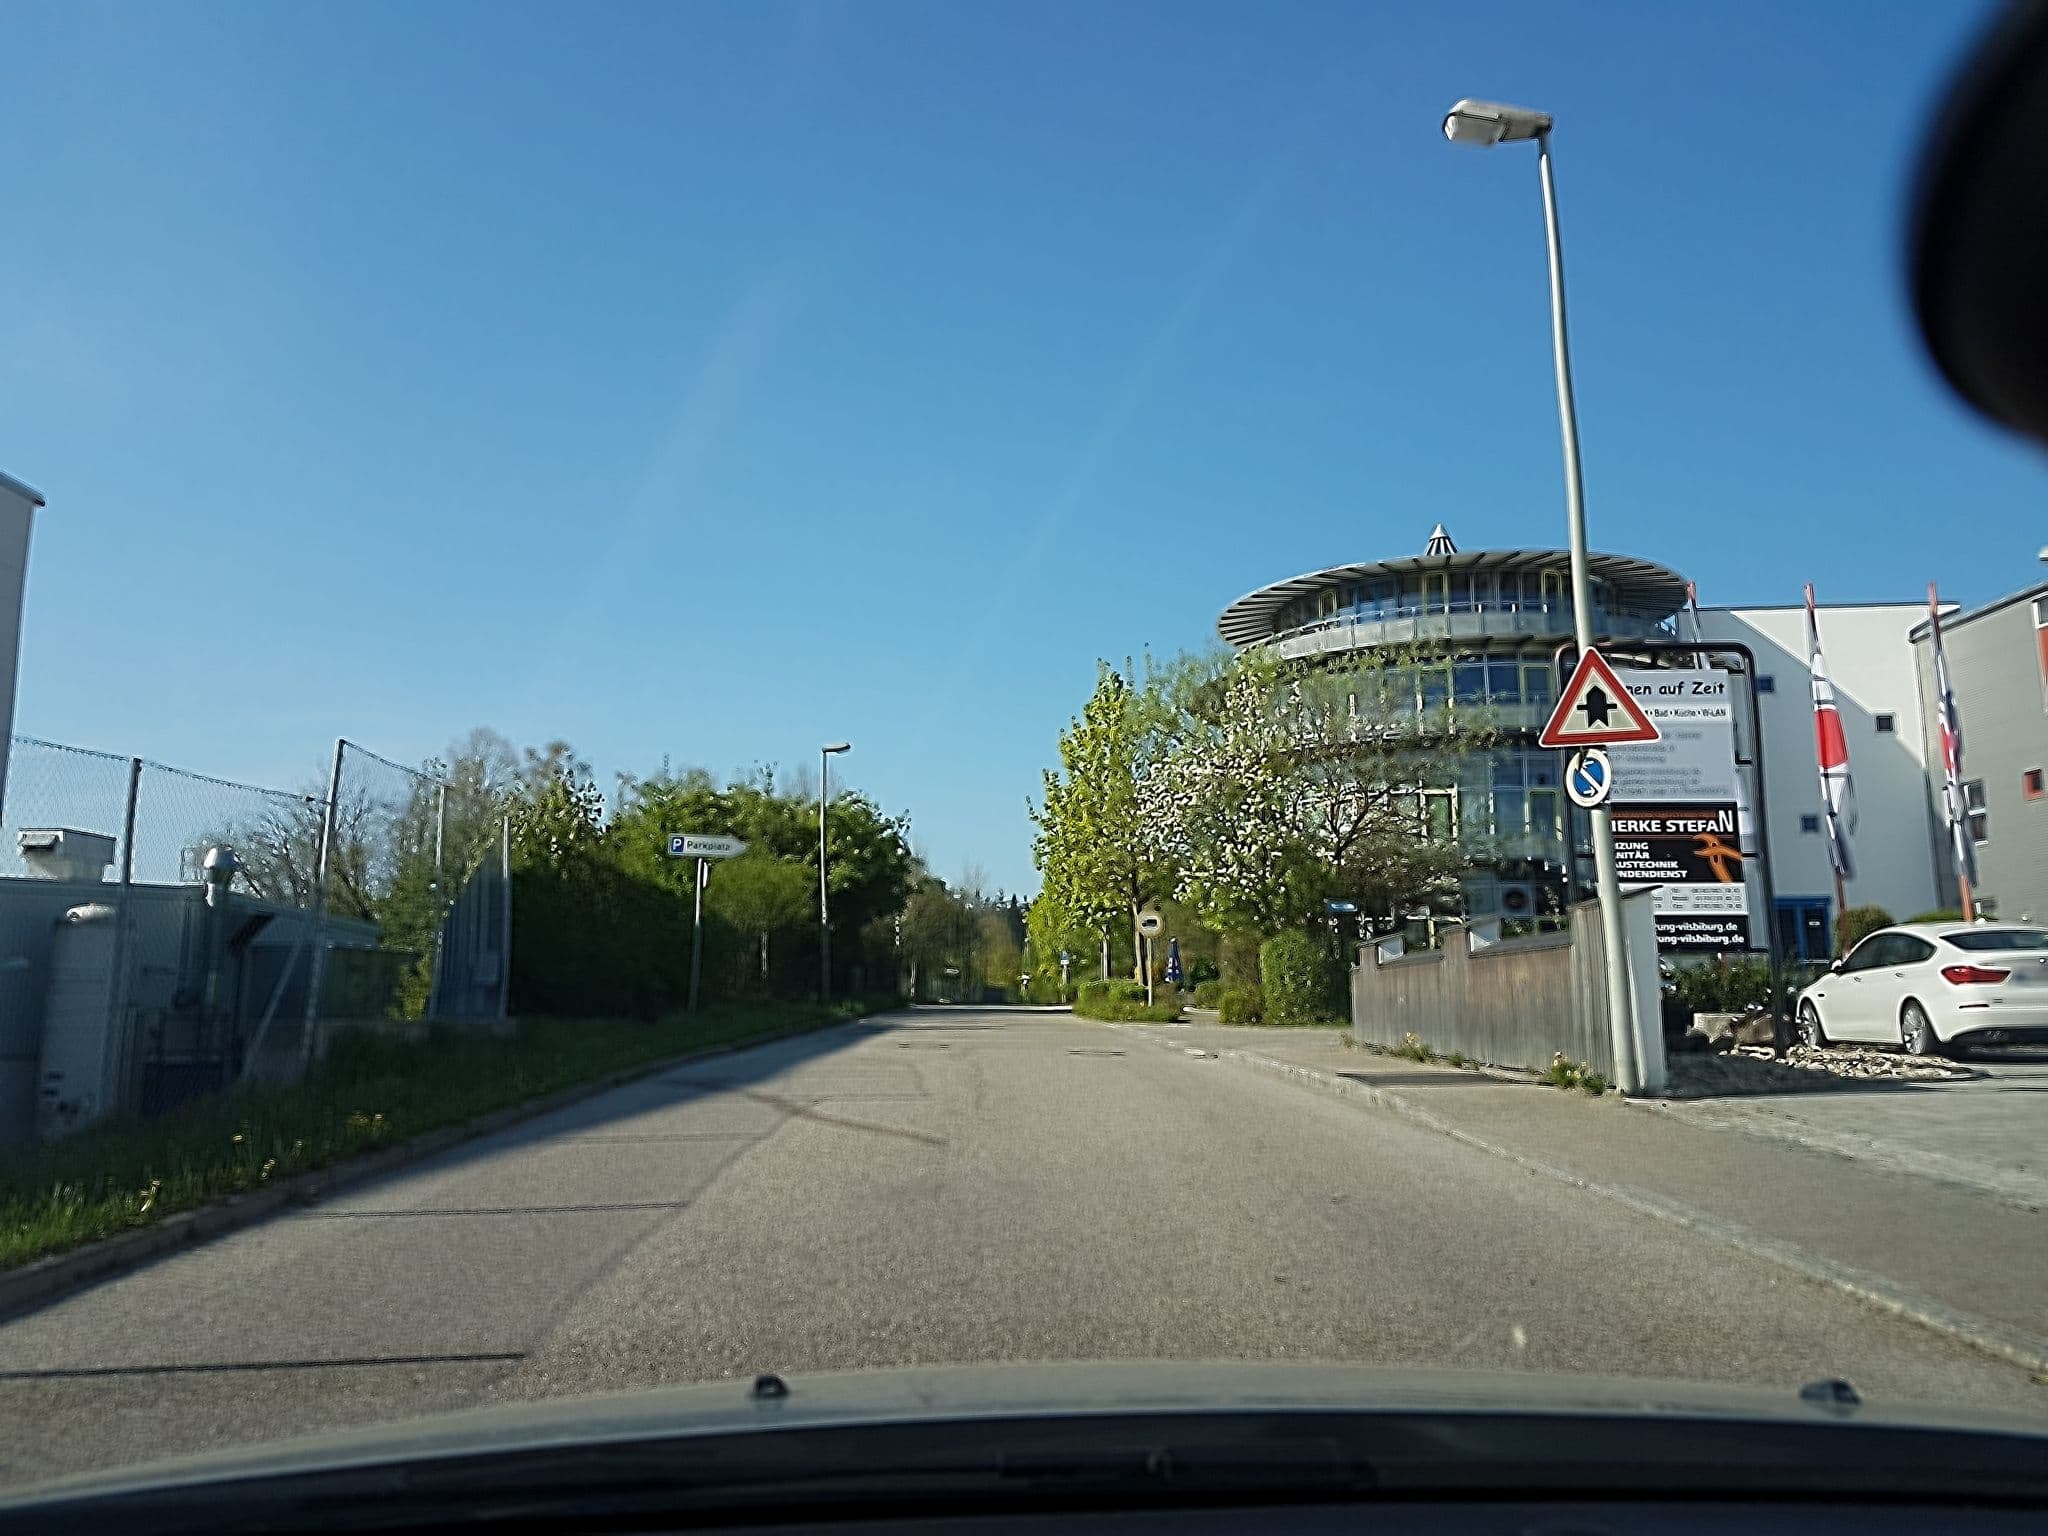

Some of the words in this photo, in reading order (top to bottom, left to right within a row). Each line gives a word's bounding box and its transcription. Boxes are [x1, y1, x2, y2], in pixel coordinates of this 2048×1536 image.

[1659, 681, 1684, 695] auf
[1692, 681, 1725, 695] Zeit
[1665, 810, 1734, 832] STEFAN
[672, 838, 682, 850] P
[686, 840, 731, 851] Parkplatz
